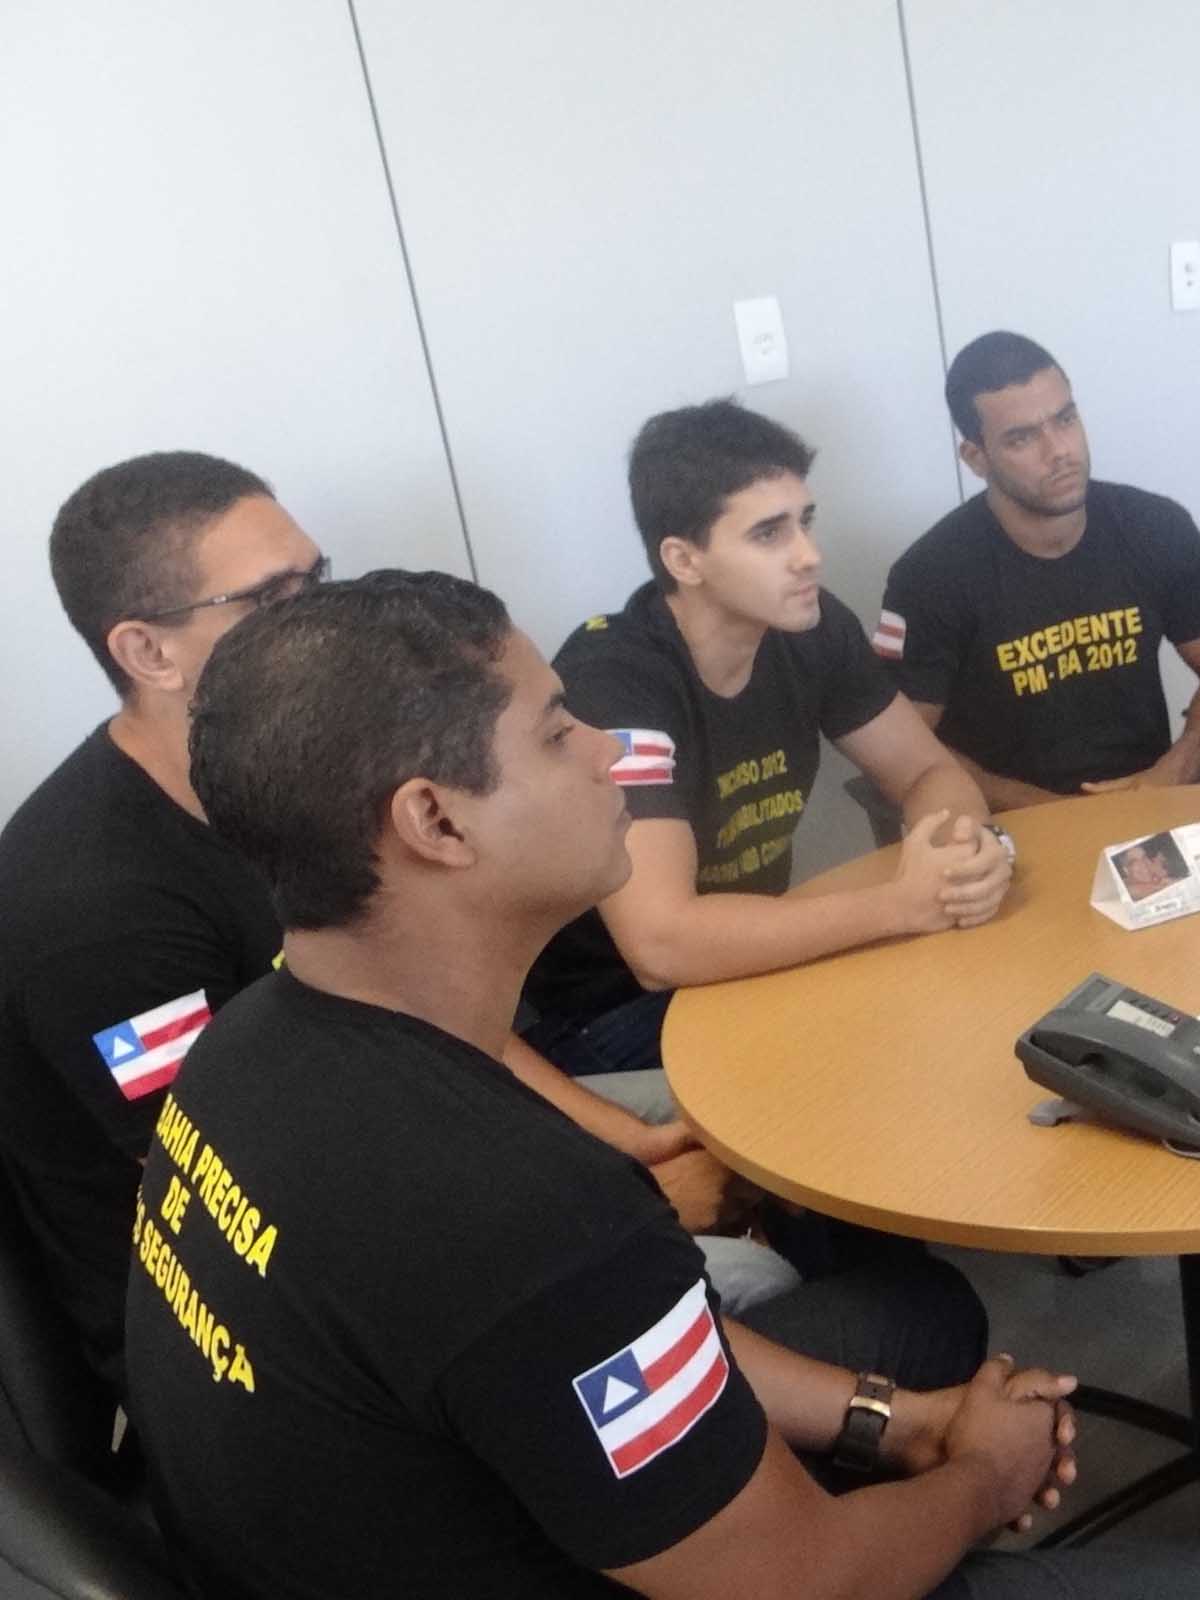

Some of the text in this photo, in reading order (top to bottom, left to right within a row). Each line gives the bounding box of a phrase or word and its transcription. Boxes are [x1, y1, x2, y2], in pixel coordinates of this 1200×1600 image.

[996, 606, 1143, 671] EXCEDENTE
[1086, 639, 1137, 671] 2012
[161, 1175, 191, 1235] DE
[191, 1143, 278, 1278] PRECISA
[139, 1219, 255, 1393] SEGURANÇA
